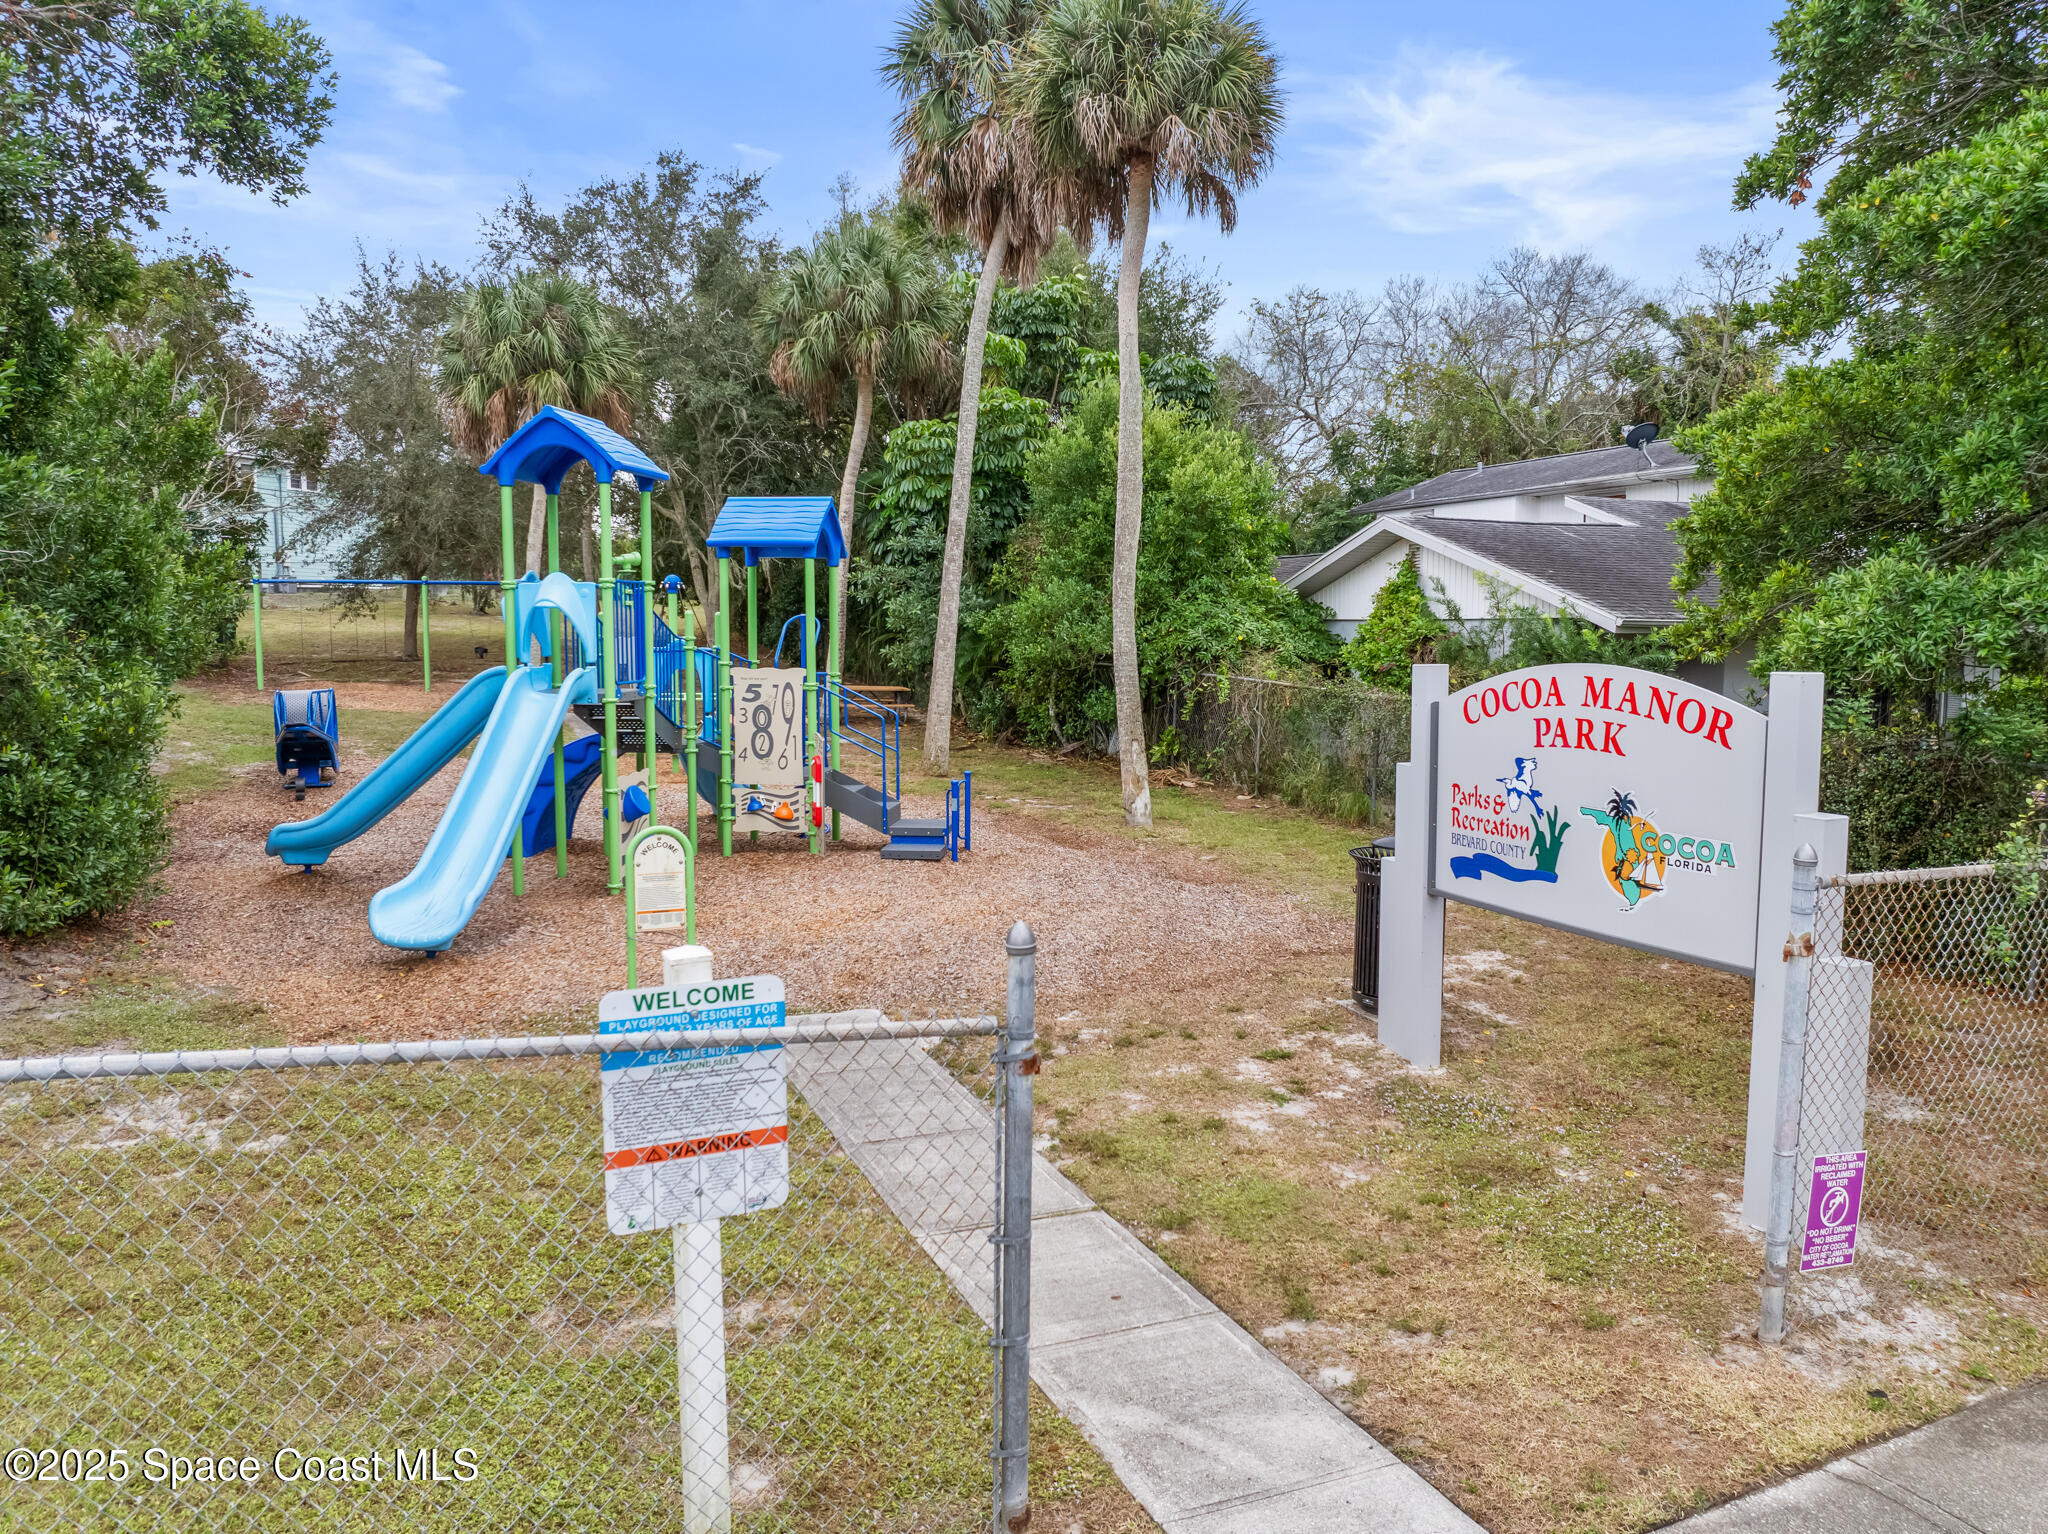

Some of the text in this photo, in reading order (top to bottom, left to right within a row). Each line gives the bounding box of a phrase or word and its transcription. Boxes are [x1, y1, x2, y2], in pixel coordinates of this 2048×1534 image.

[742, 683, 762, 703] 5
[738, 707, 748, 723] 3
[1463, 676, 1734, 750] COCOA MANOR
[751, 704, 774, 760] 8
[1533, 717, 1628, 757] PARK
[758, 734, 766, 751] 2
[738, 747, 748, 762] 4
[778, 748, 788, 770] 6
[1451, 783, 1506, 815] Parks &
[1451, 807, 1529, 841] Recreation
[640, 841, 679, 856] WELCOME
[1451, 833, 1526, 860] BREVARD COUNTY
[1641, 831, 1735, 868] COCOA
[1659, 856, 1712, 873] FLORIDA
[632, 982, 755, 1012] WELCOME
[608, 1013, 690, 1032] PLAYGROUND
[755, 1003, 778, 1014] FOR
[736, 1017, 752, 1027] OF
[666, 1133, 752, 1157] WARNING
[1815, 1161, 1863, 1173] IRRIGATED WITH
[1825, 1153, 1857, 1164] THIS AREA
[1821, 1170, 1856, 1181] RECLAIMED
[1826, 1178, 1848, 1188] WATER
[1820, 1227, 1833, 1236] NOT
[1809, 1242, 1849, 1253] CITY OF COCOA
